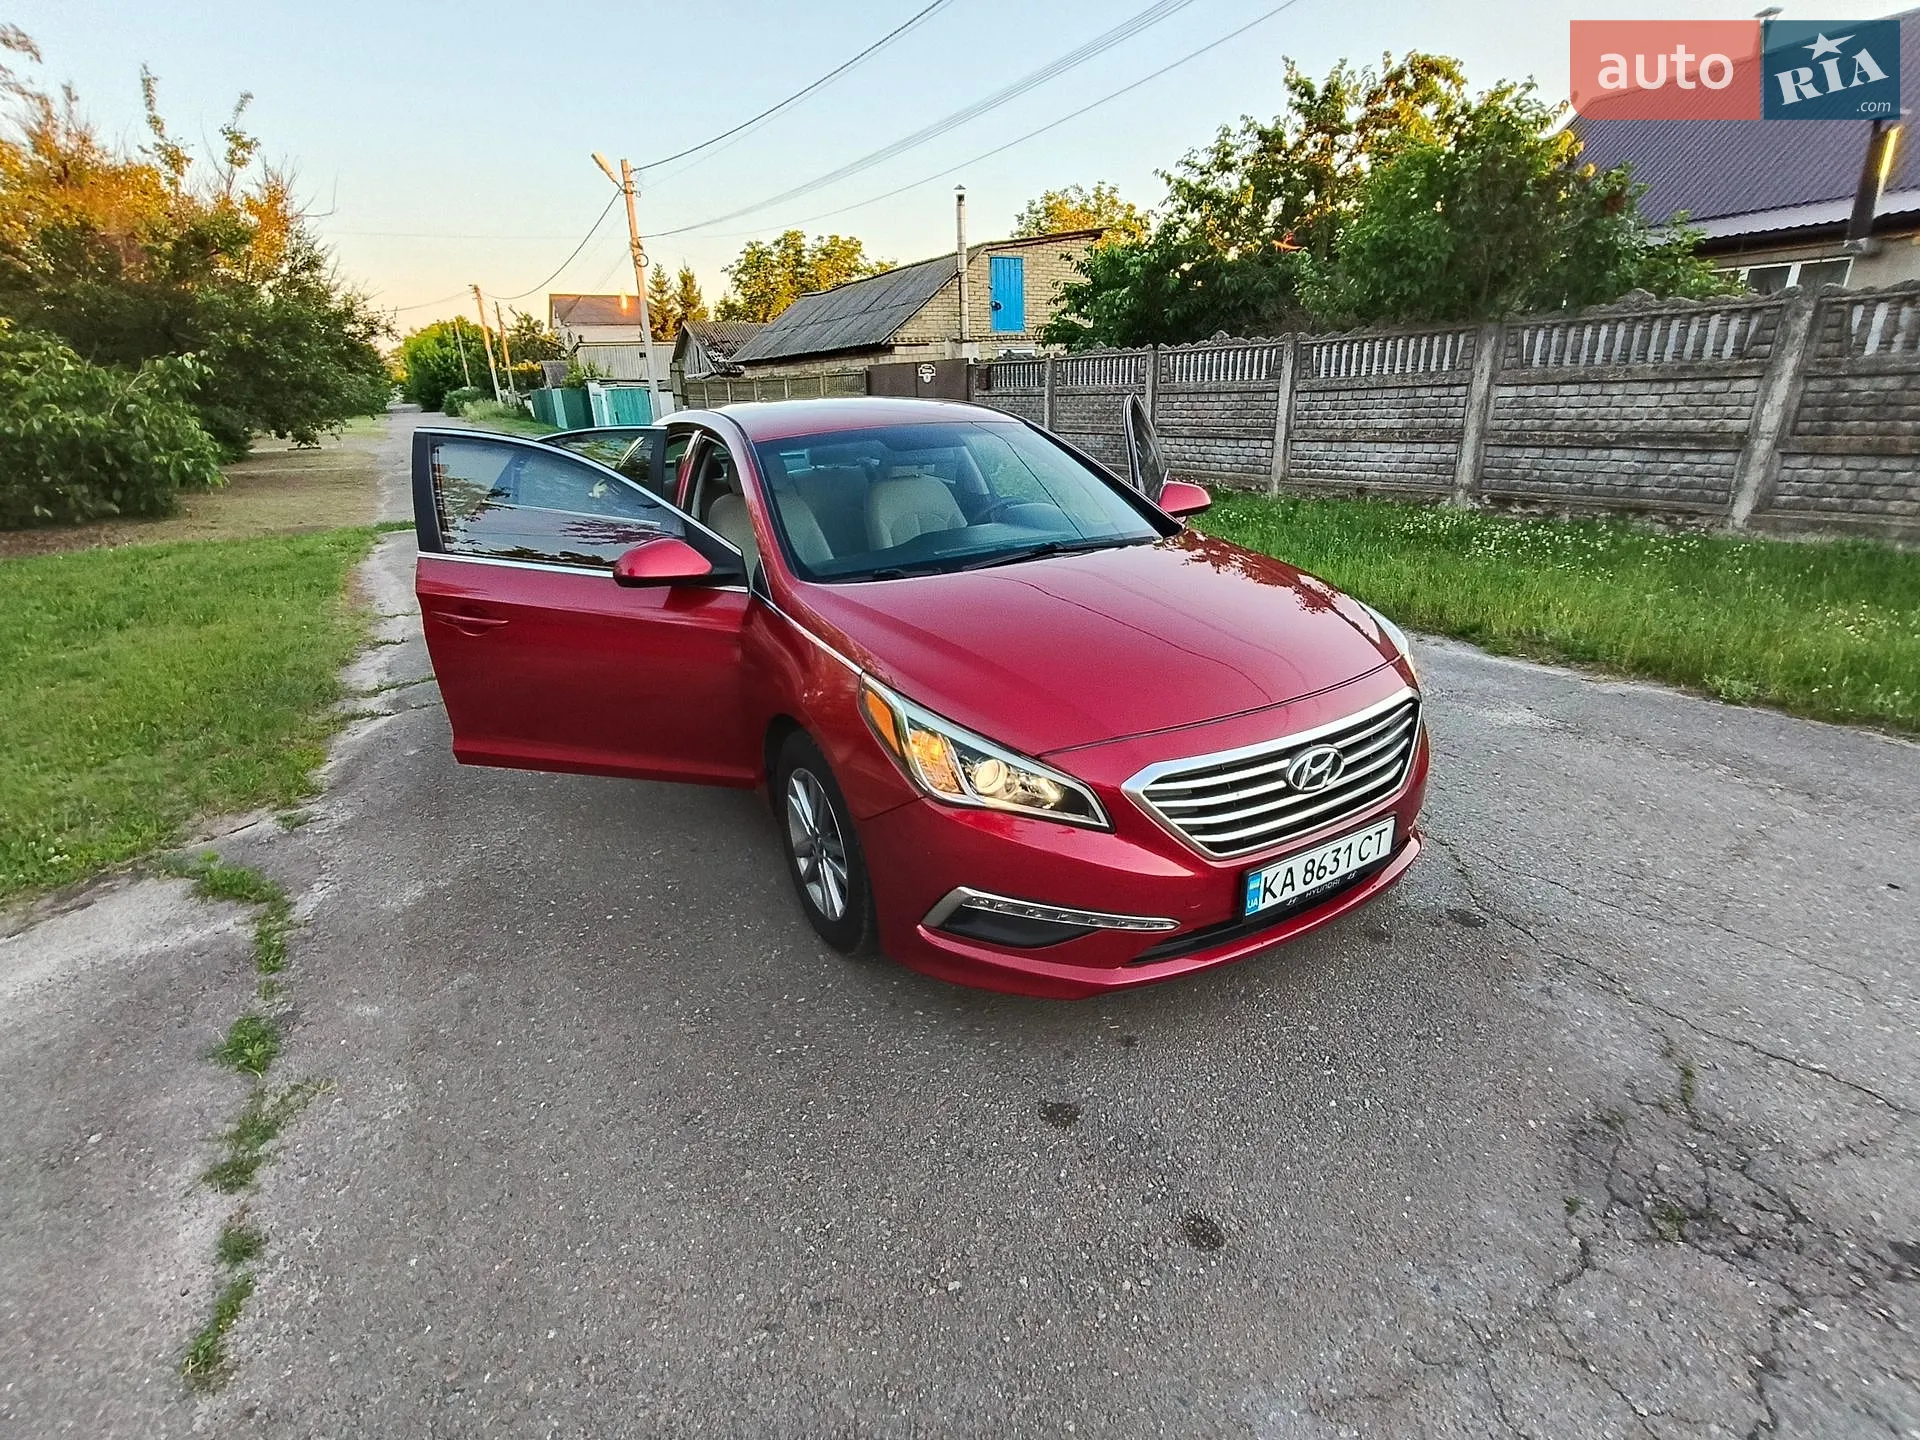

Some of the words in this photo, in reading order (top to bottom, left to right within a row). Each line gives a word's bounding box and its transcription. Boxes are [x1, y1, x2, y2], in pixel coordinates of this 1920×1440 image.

[1262, 867, 1296, 904] KA
[1302, 843, 1353, 885] 8631
[1358, 828, 1388, 862] CT
[1305, 878, 1341, 898] HYUNDAI
[1247, 898, 1259, 909] UA
